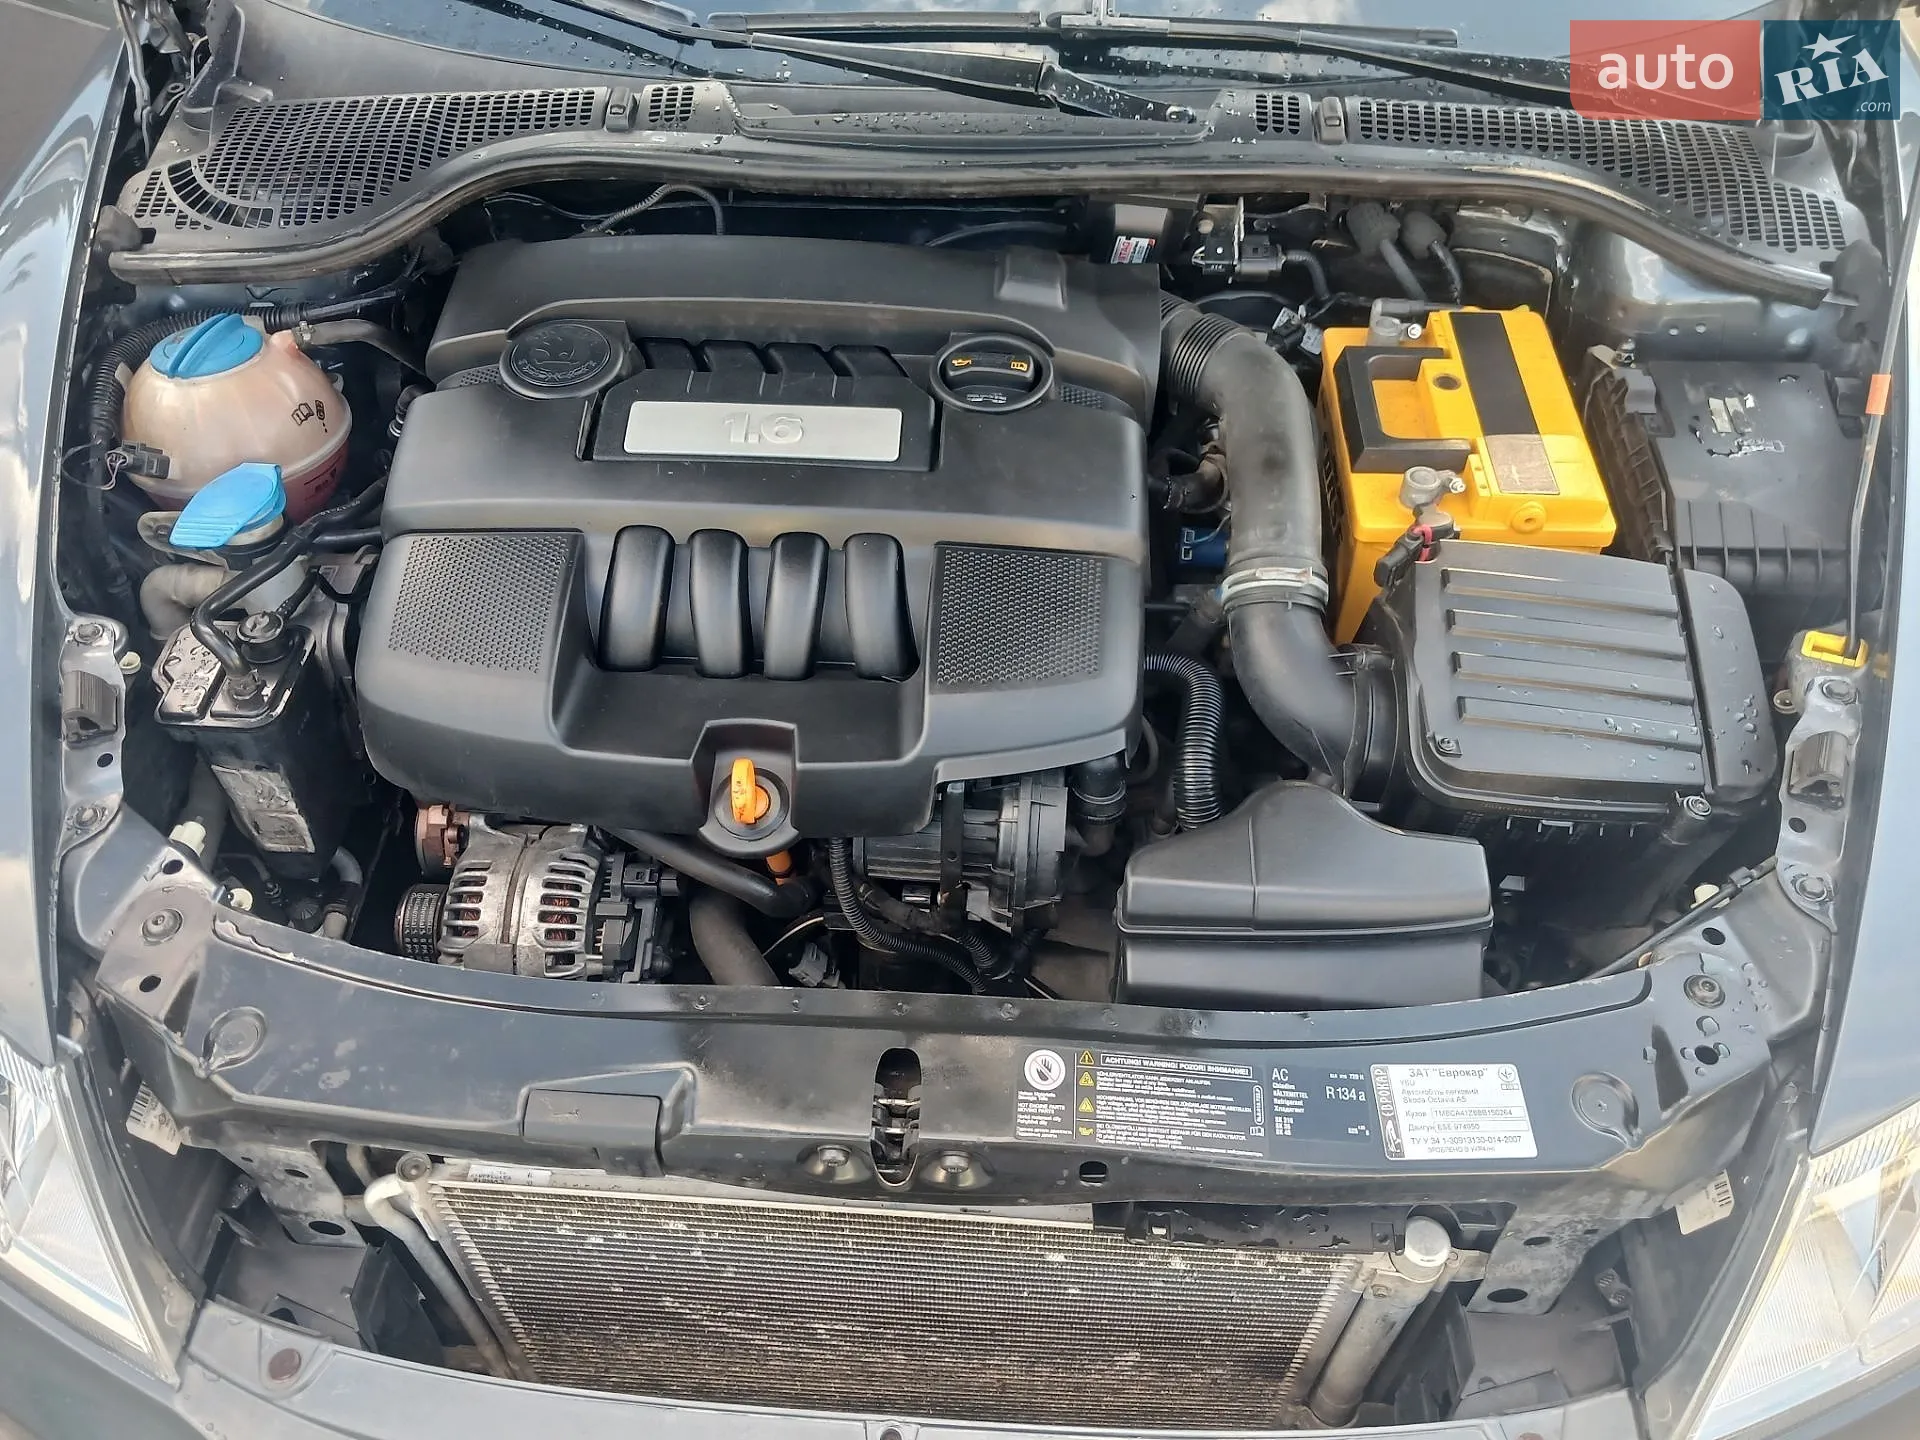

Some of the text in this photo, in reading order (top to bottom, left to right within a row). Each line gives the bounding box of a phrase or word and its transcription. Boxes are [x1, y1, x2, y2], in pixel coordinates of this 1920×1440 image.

[722, 412, 804, 444] 1.6
[1272, 1068, 1289, 1081] AC
[1409, 1068, 1429, 1077] ЗАТ
